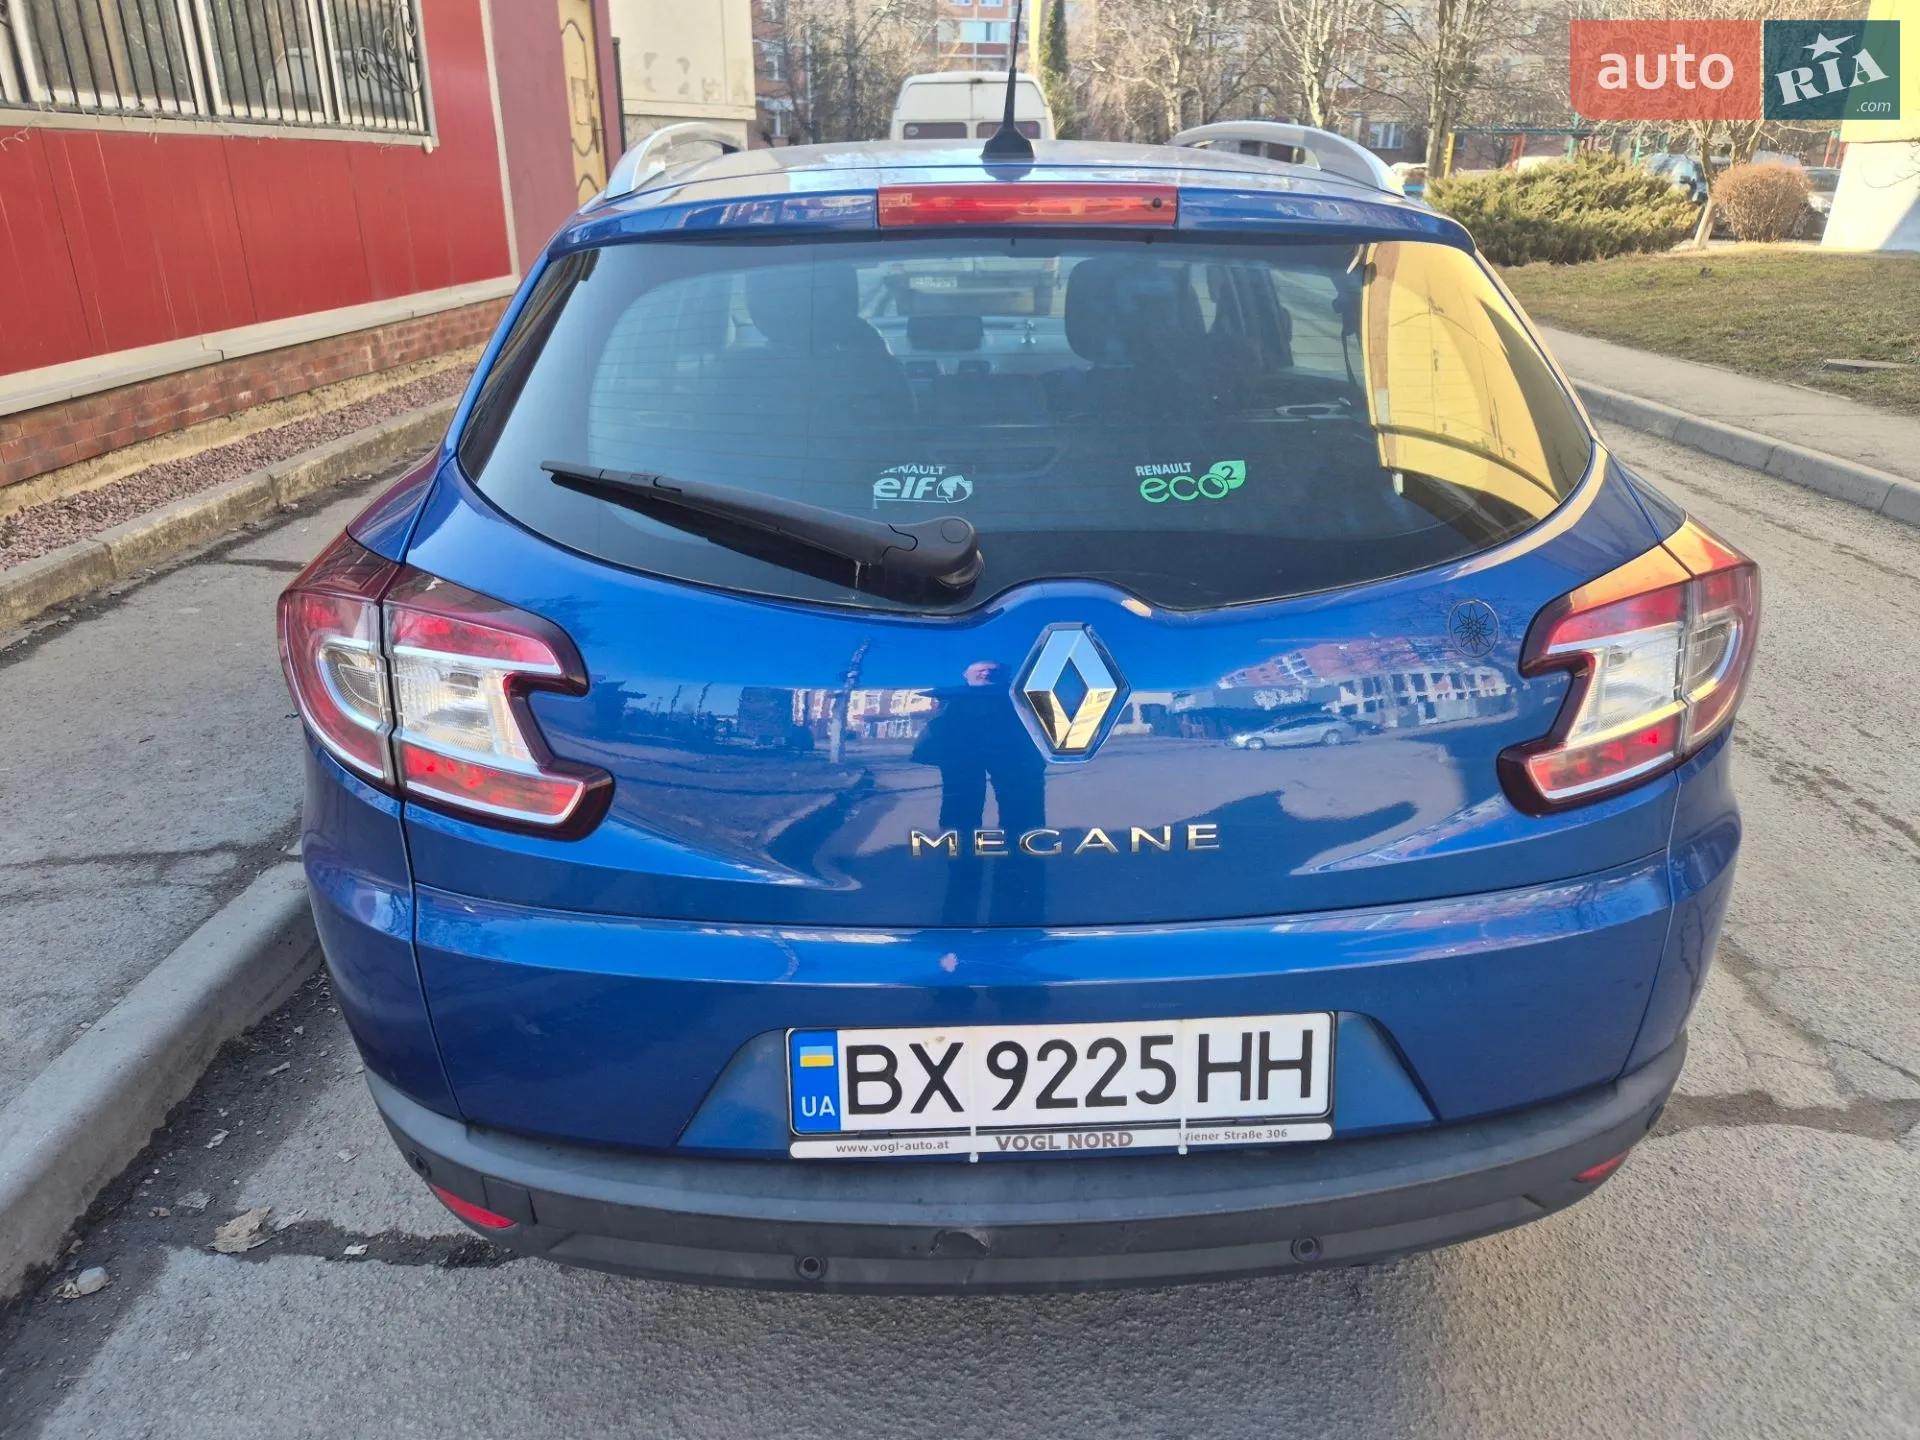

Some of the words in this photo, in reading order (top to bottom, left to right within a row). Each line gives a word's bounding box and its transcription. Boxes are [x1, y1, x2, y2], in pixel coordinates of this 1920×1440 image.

[1135, 462, 1192, 476] RENAULT
[911, 823, 1220, 856] MEGANE
[846, 1042, 965, 1115] BX
[986, 1034, 1177, 1112] 9225
[1197, 1030, 1313, 1103] HH
[801, 1096, 836, 1118] UA
[835, 1140, 950, 1153] www.vogl-auto.at
[995, 1135, 1061, 1151] VOGL
[1067, 1131, 1134, 1149] NORD
[1223, 1129, 1263, 1141] Straße
[1265, 1128, 1288, 1140] 306
